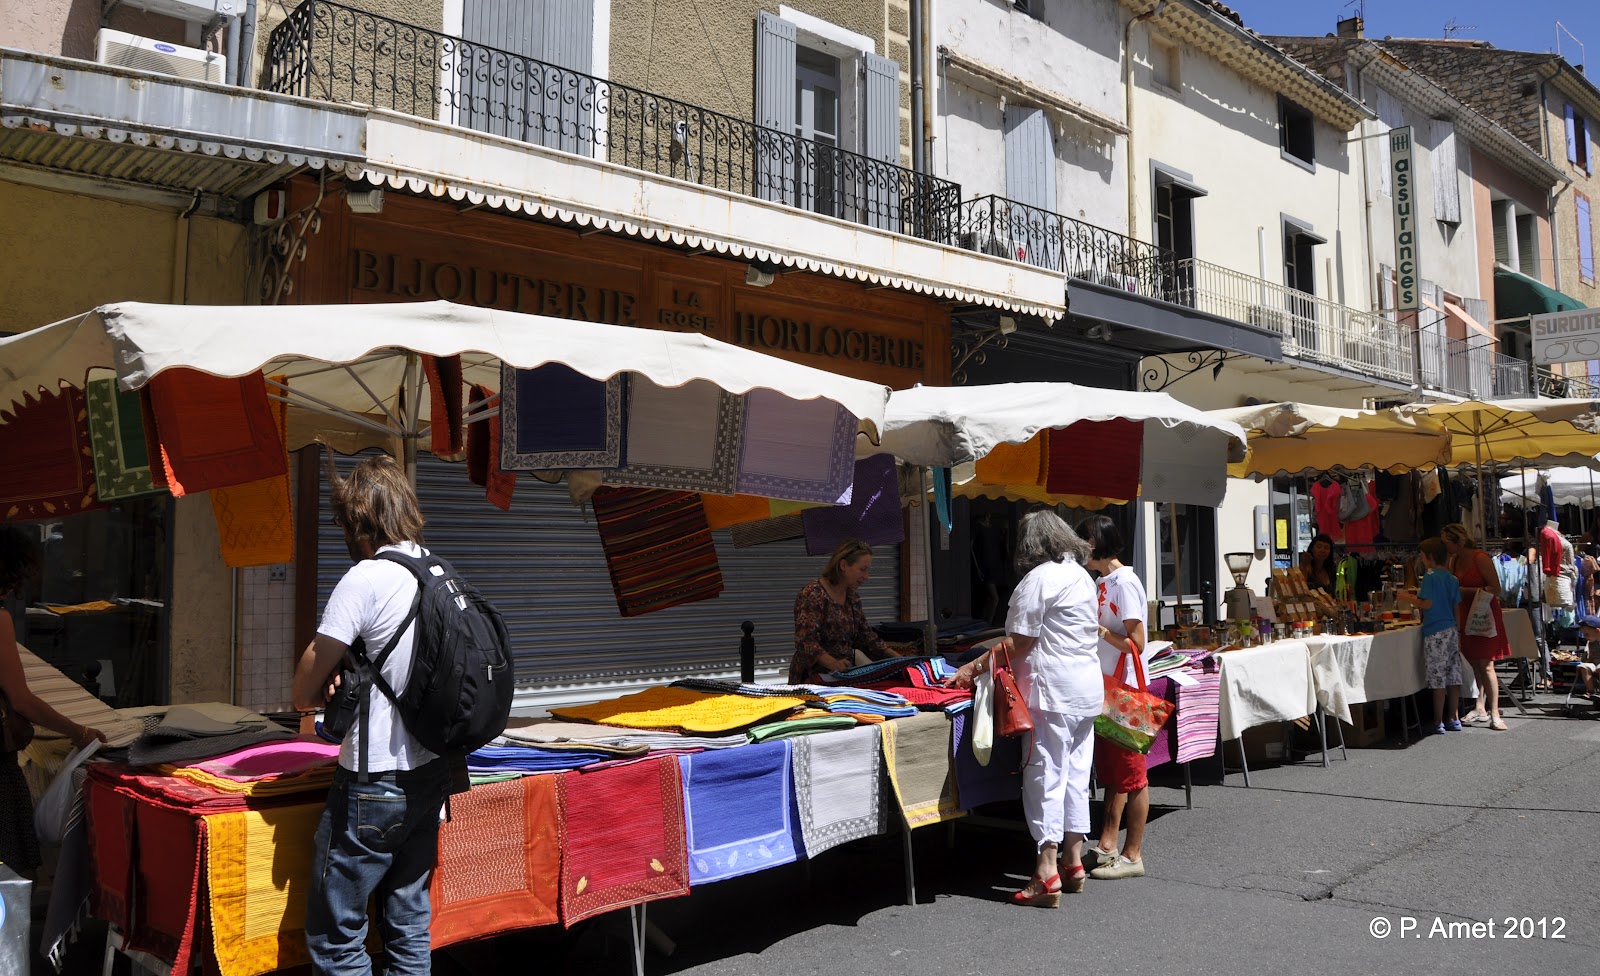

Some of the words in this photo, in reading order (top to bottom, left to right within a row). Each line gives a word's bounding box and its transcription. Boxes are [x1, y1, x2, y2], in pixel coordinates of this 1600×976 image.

[1395, 158, 1413, 304] assurances
[354, 249, 638, 326] BIJOUTERIE
[673, 288, 704, 308] LA
[659, 308, 717, 330] ROSE
[736, 311, 925, 370] HORLOGERIE
